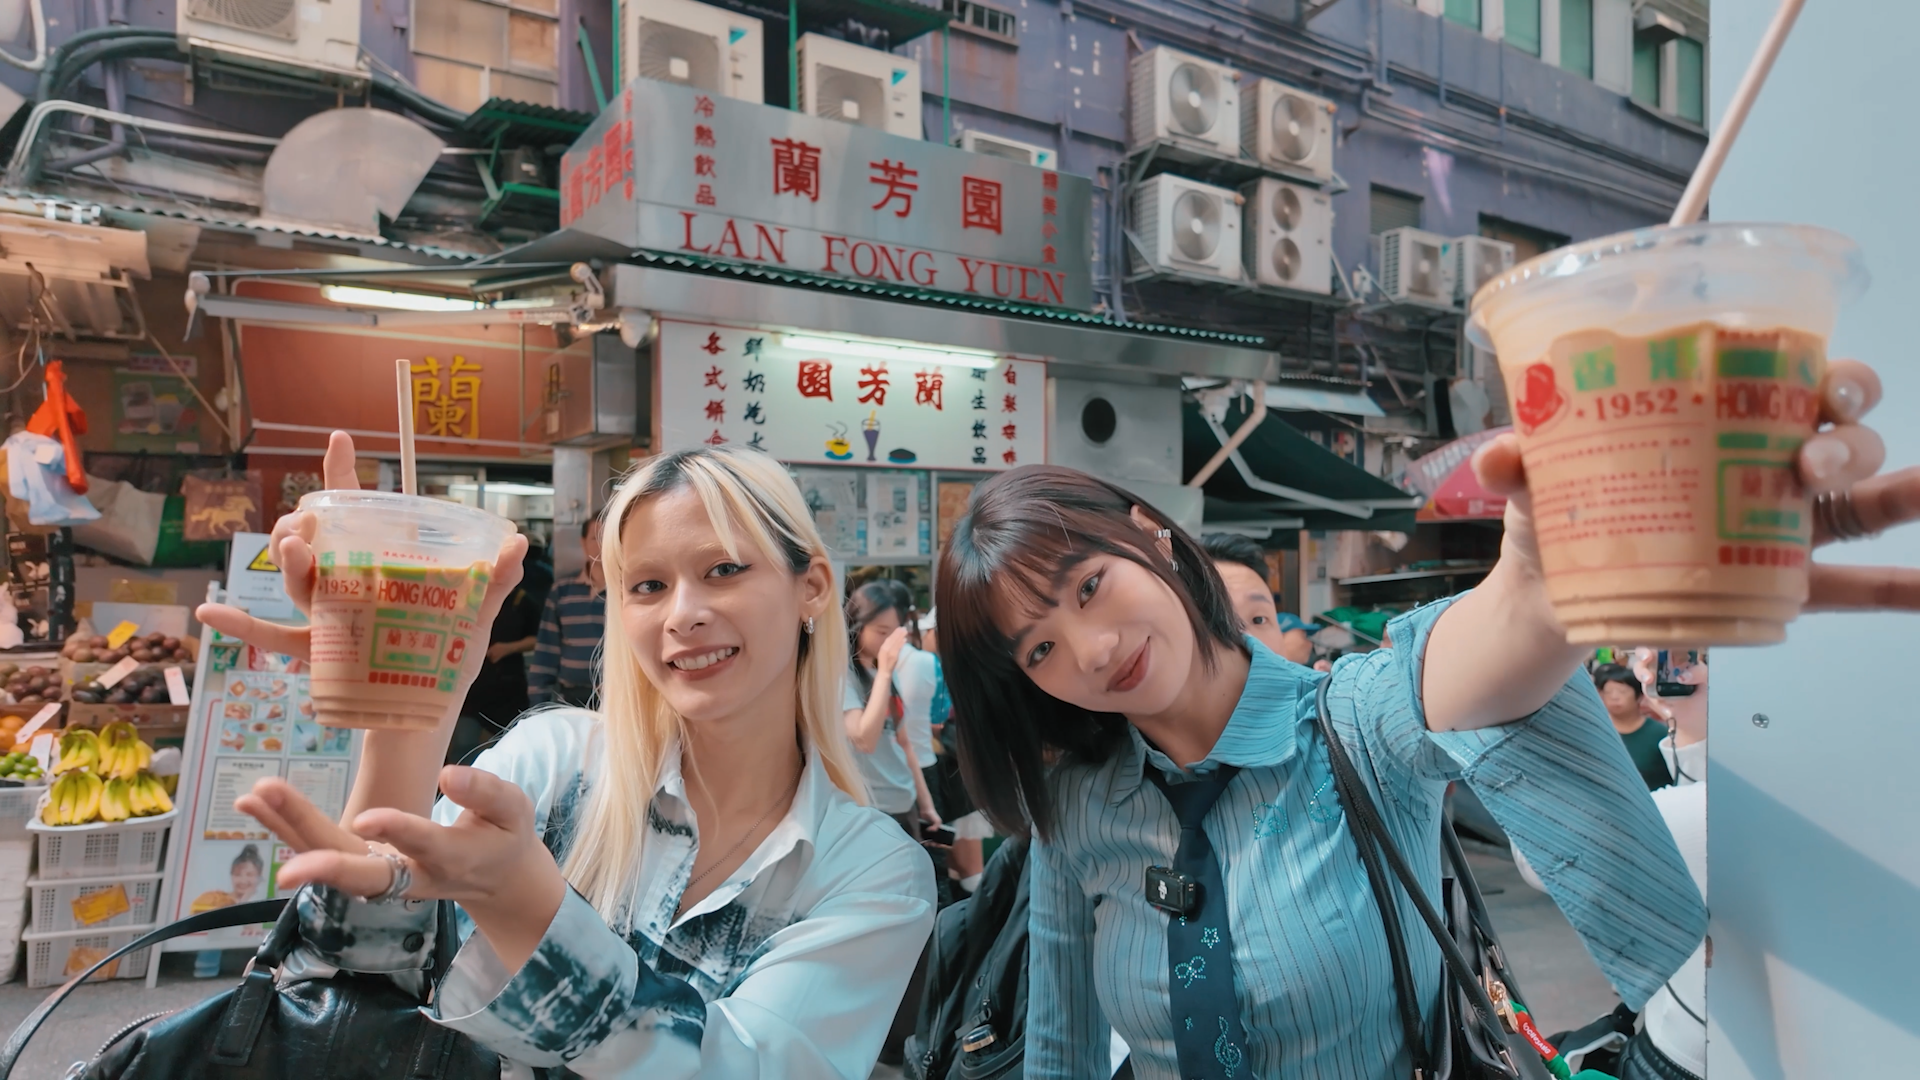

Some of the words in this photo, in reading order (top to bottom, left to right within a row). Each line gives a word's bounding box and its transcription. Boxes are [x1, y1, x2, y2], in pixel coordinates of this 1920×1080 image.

[694, 94, 717, 206] 冷熱飲品
[770, 137, 1003, 236] 蘭芳園
[678, 211, 789, 263] LAN
[822, 236, 939, 287] FONG
[957, 256, 1067, 304] YUEN
[410, 355, 483, 440] 蘭
[1594, 387, 1678, 421] 1952
[323, 579, 360, 596] 1952
[378, 580, 420, 605] HONG
[422, 585, 457, 610] KONG
